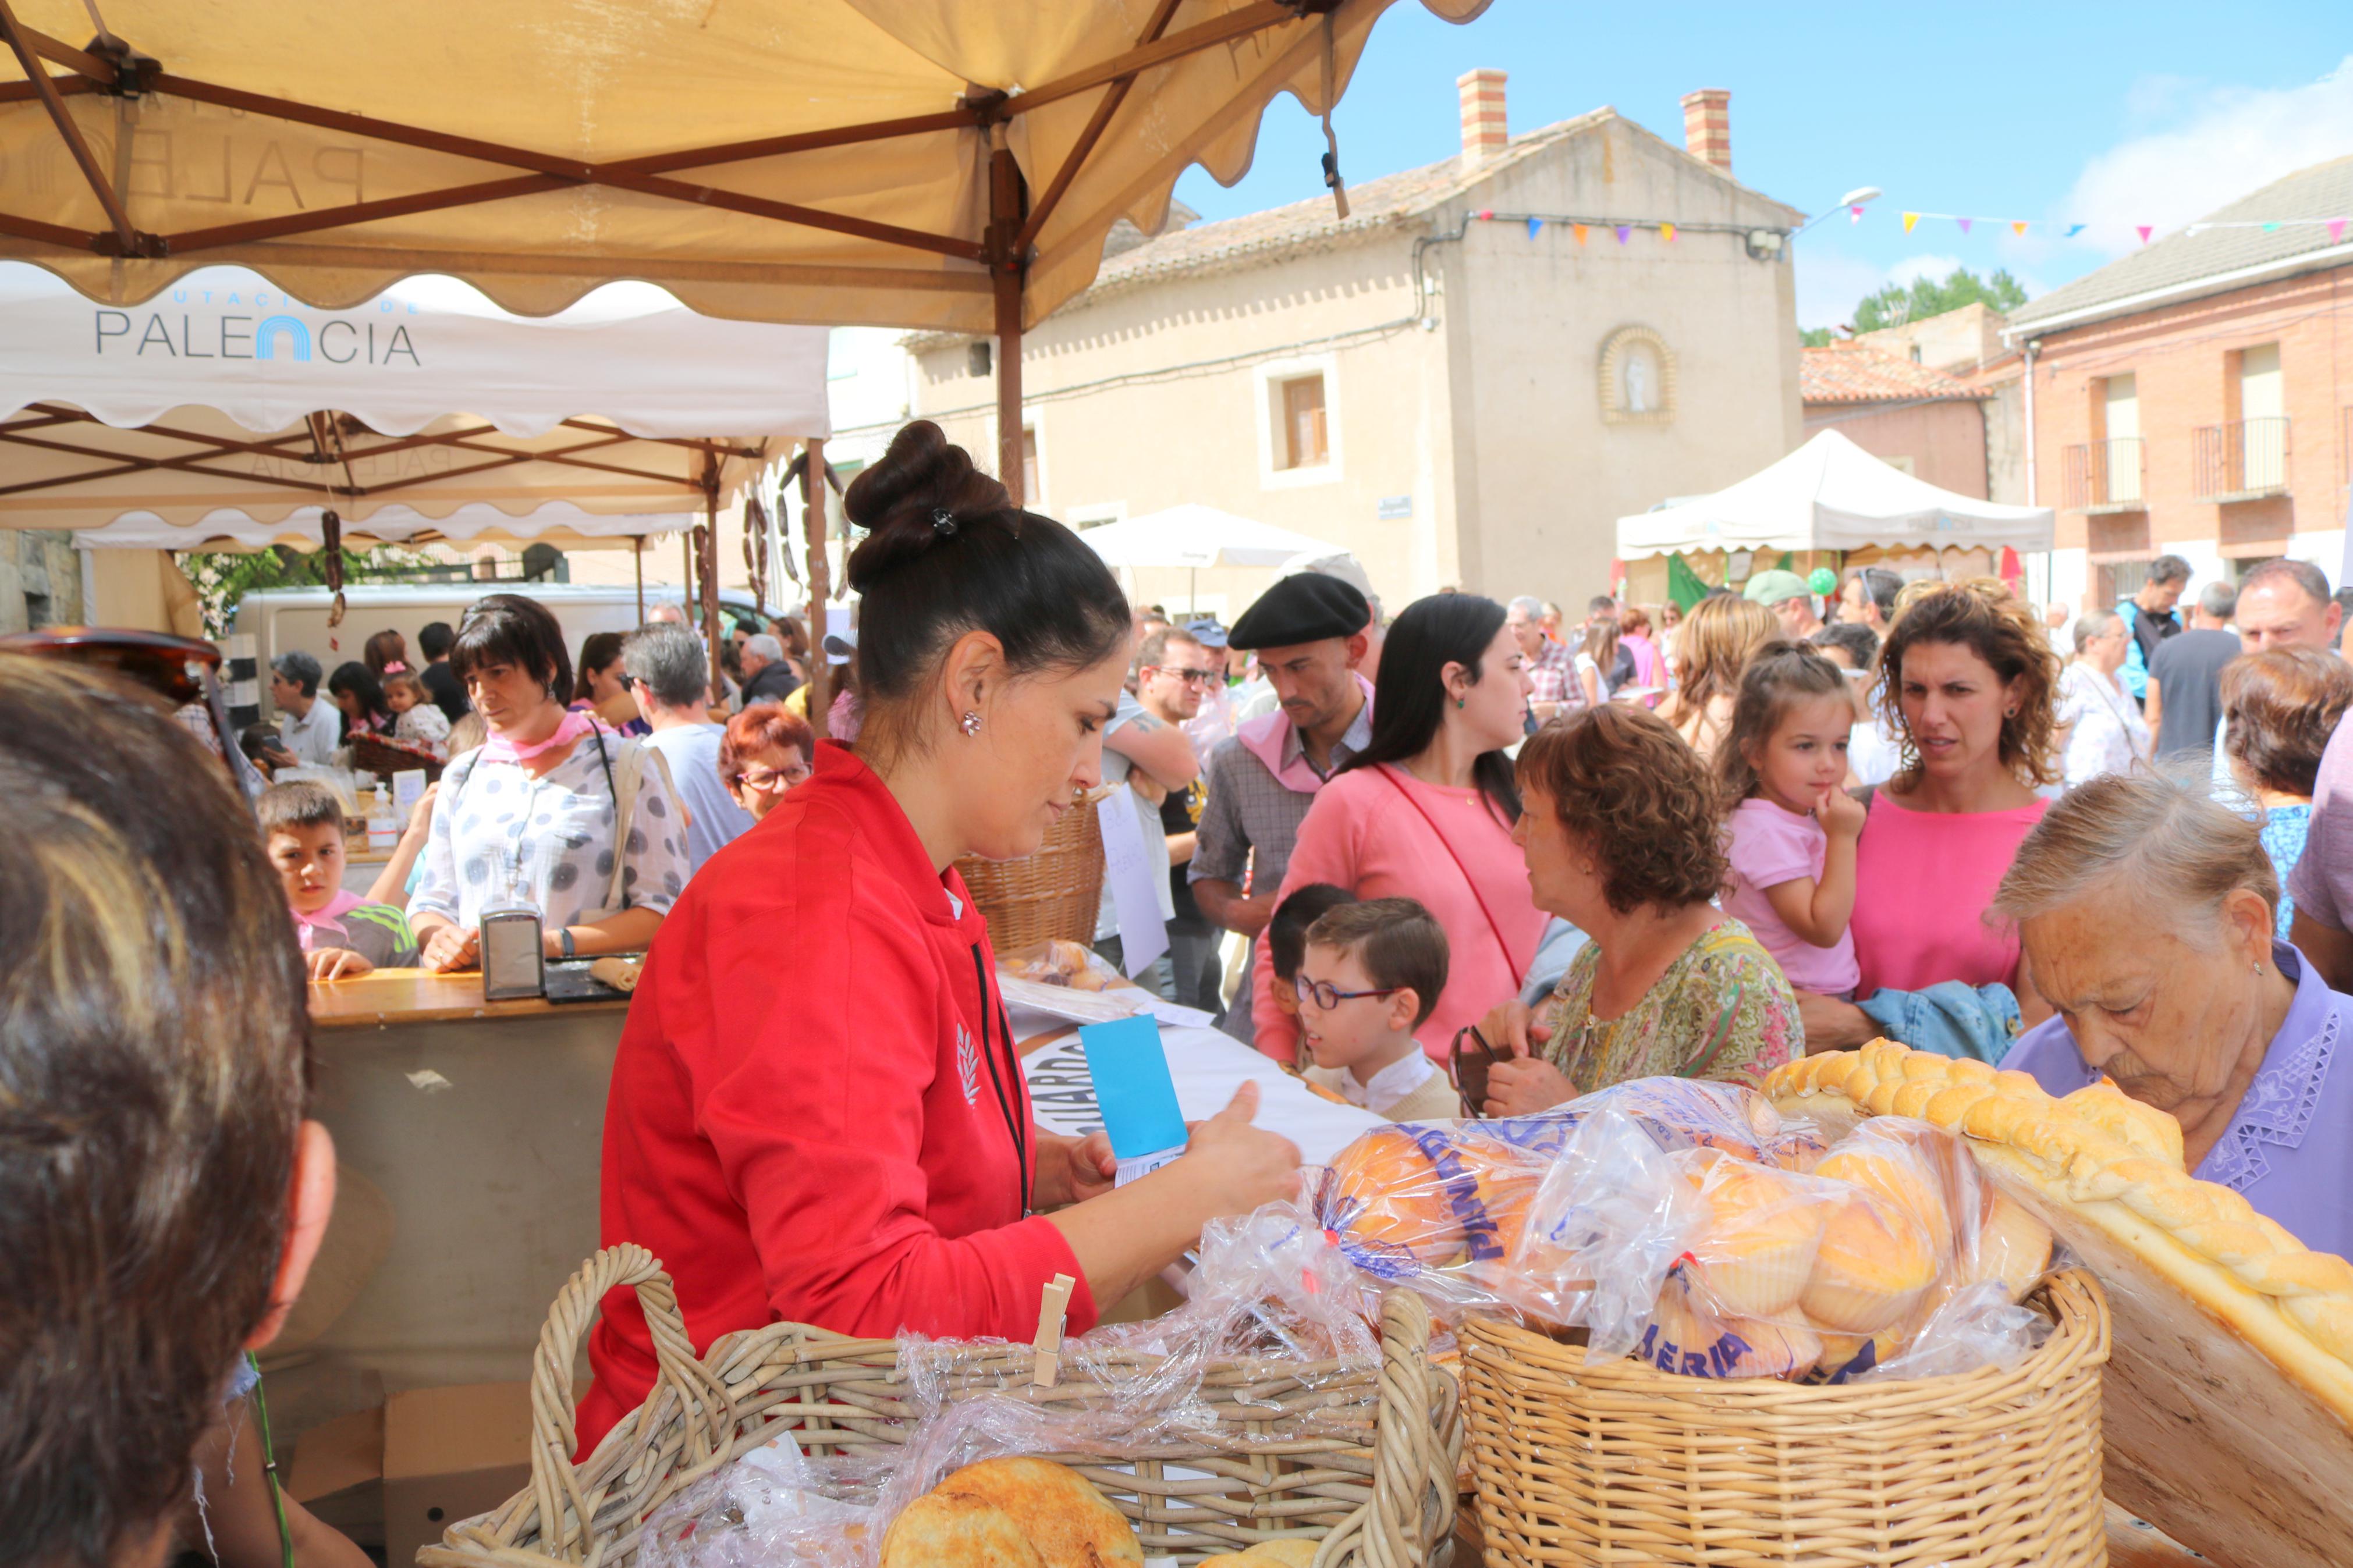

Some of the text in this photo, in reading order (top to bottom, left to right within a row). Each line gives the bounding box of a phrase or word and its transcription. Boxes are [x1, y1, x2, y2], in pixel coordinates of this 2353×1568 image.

[173, 289, 420, 315] UTACI DE
[1028, 1042, 1108, 1136] UARD
